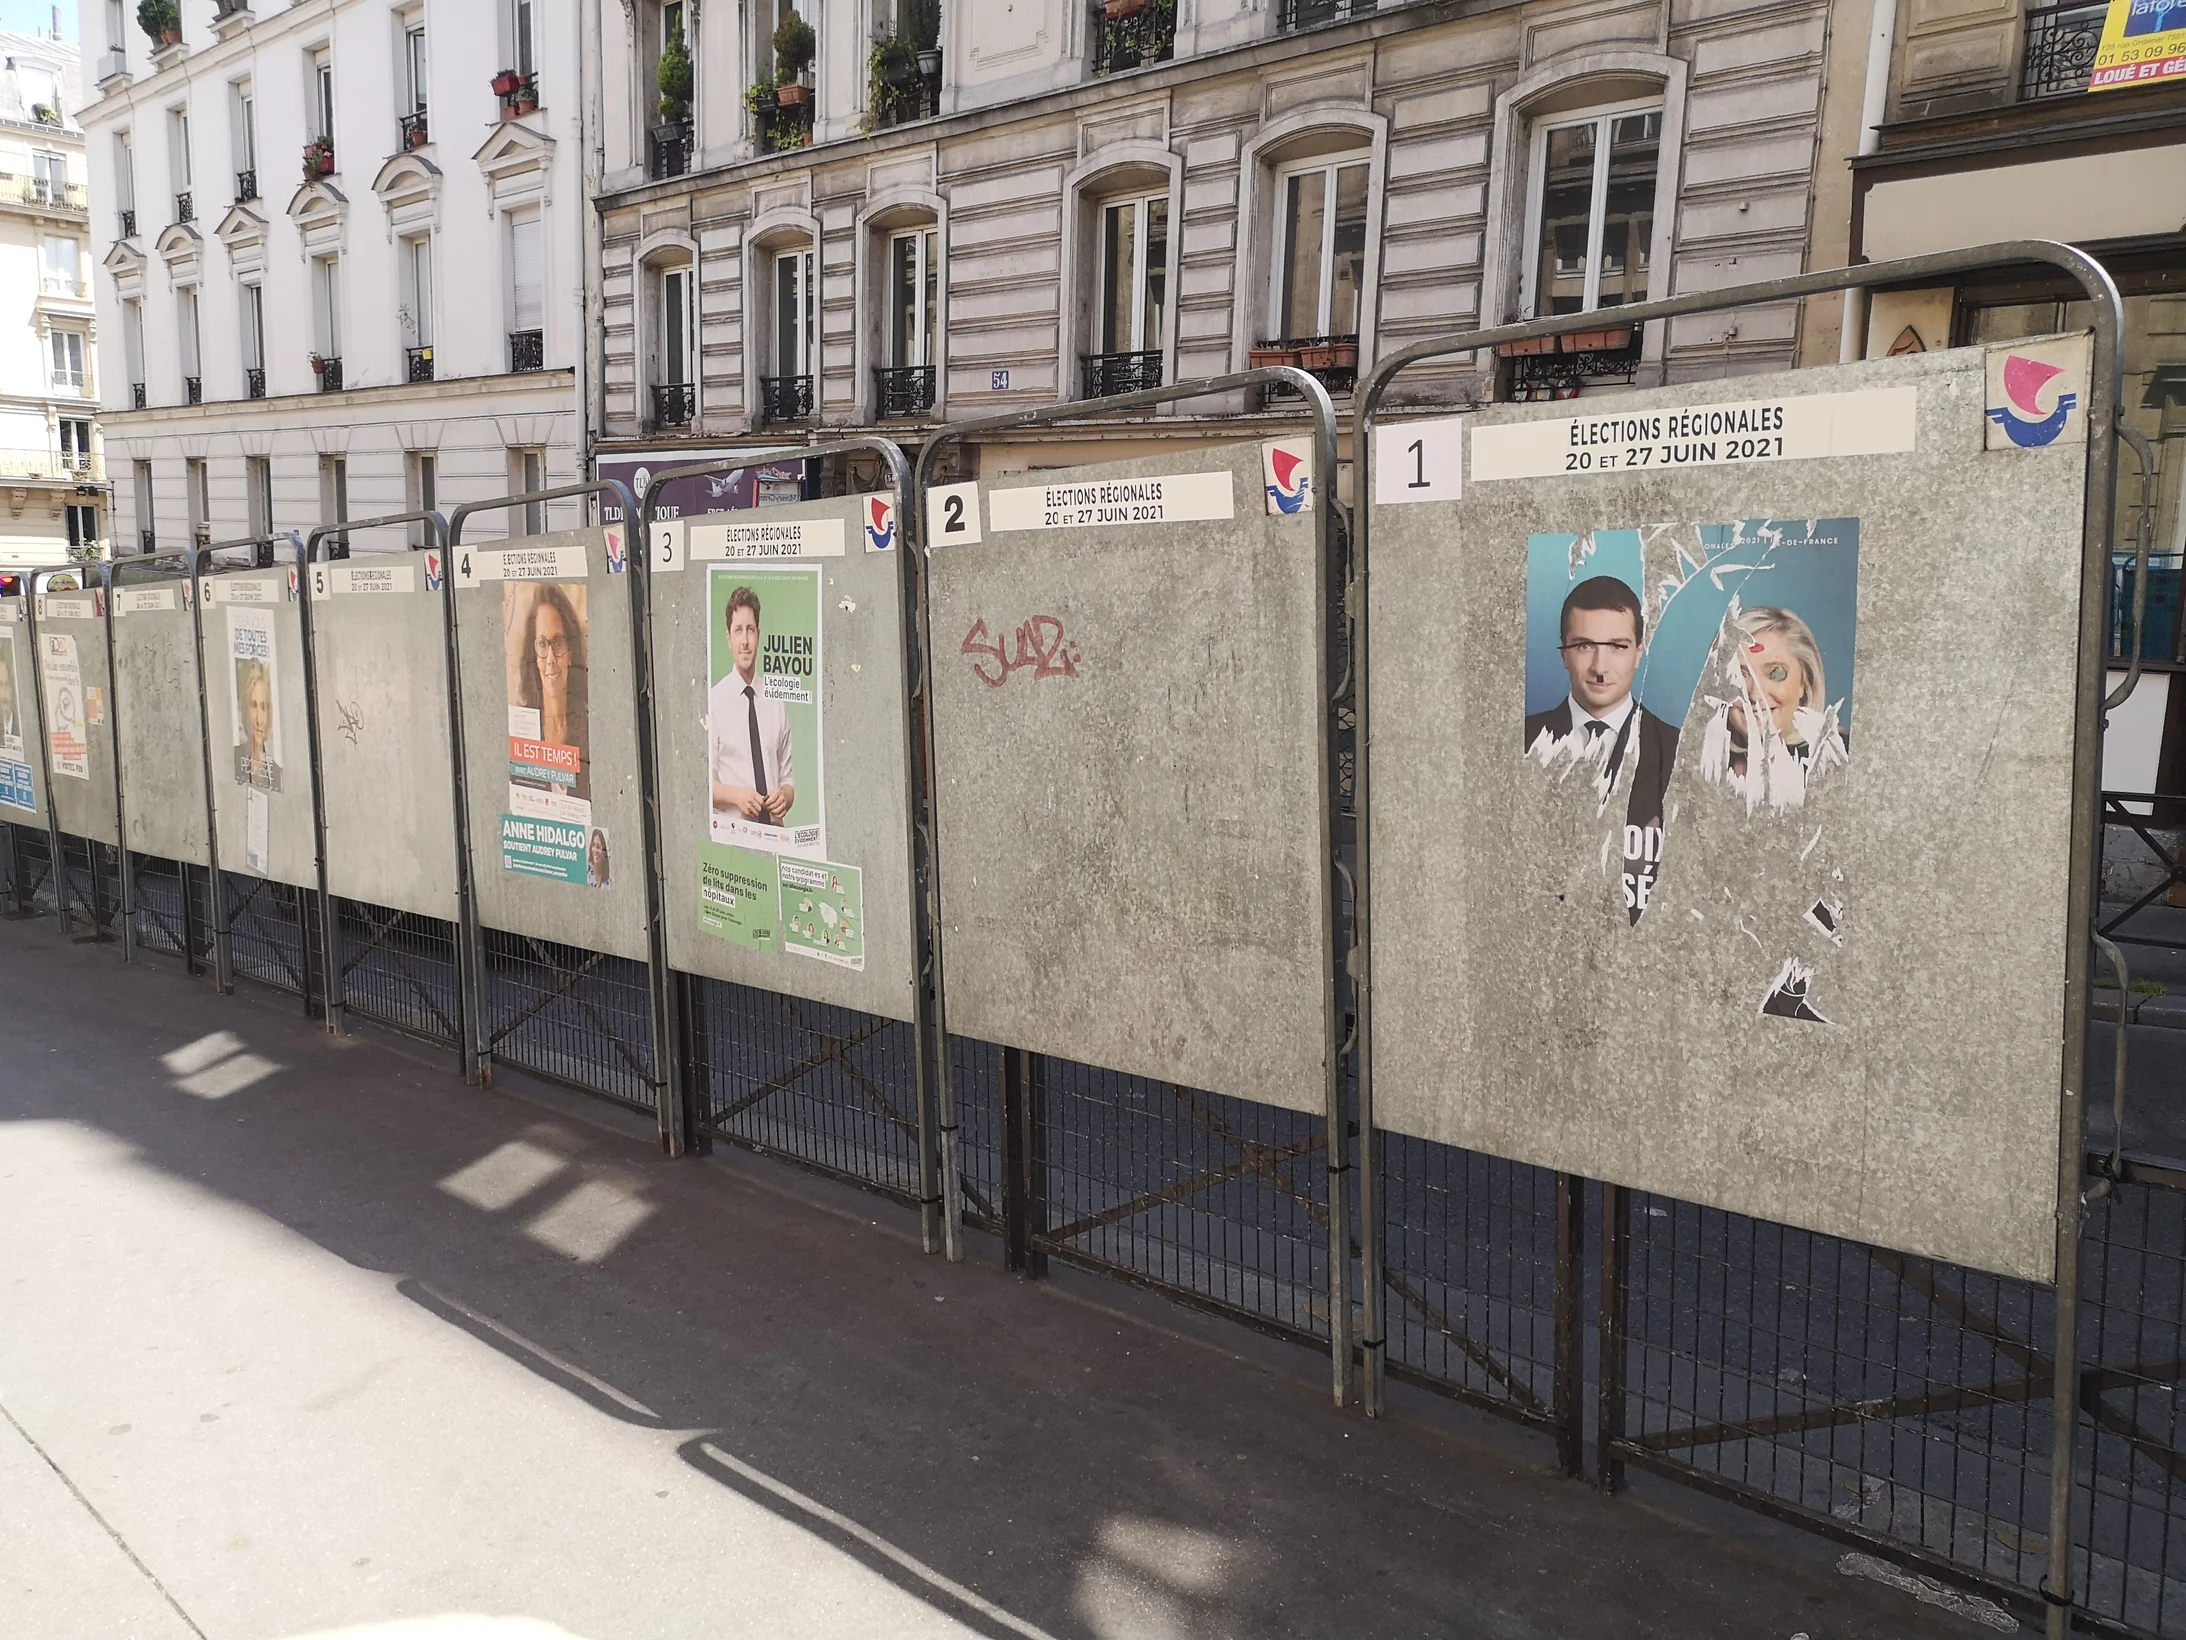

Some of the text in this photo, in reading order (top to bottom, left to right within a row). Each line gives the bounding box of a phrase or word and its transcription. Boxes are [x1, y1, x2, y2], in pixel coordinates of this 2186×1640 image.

[2098, 42, 2186, 66] 01 53 09 96
[2094, 64, 2137, 85] LOUÉ
[2139, 63, 2160, 78] ET
[993, 371, 1008, 389] 54
[1570, 408, 1784, 447] ÉLECTIONS RÉGIONALES
[1406, 438, 1431, 488] 1
[1565, 437, 1783, 471] 20 ET 27 JUIN 2021
[1046, 482, 1163, 507] ÉLECTIONS RÉGIONALES
[944, 495, 965, 532] 2
[1044, 505, 1164, 525] 20 ET 27 JUIN 2021
[726, 523, 802, 543] ÉLECTIONS RÉGIONALES
[502, 550, 556, 565] ÉLECTIONS RÉGIONALES
[662, 532, 673, 563] 3
[725, 546, 735, 557] 20
[746, 545, 757, 556] 27
[759, 544, 779, 556] JUIN
[781, 543, 802, 555] 2021
[461, 553, 472, 578] 4
[503, 568, 511, 577] 20
[518, 567, 526, 576] 27
[527, 566, 542, 576] JUIN
[543, 565, 558, 576] 2021
[204, 582, 211, 602] 6
[316, 571, 324, 594] 5
[38, 599, 43, 615] 8
[116, 594, 121, 611] 7
[763, 634, 813, 655] JULIEN
[763, 655, 813, 676] BAYOU
[514, 742, 522, 757] IL
[523, 743, 540, 760] EST
[541, 747, 573, 766] TEMPS
[526, 766, 551, 780] AUDREY
[551, 769, 575, 785] PULVAR
[503, 820, 585, 849] ANNE HIDALGO
[503, 840, 578, 862] SOUTIENT AUDREY PULVAR
[703, 862, 720, 876] Zéro
[720, 869, 768, 892] suppression
[702, 876, 757, 901] de lits dans les
